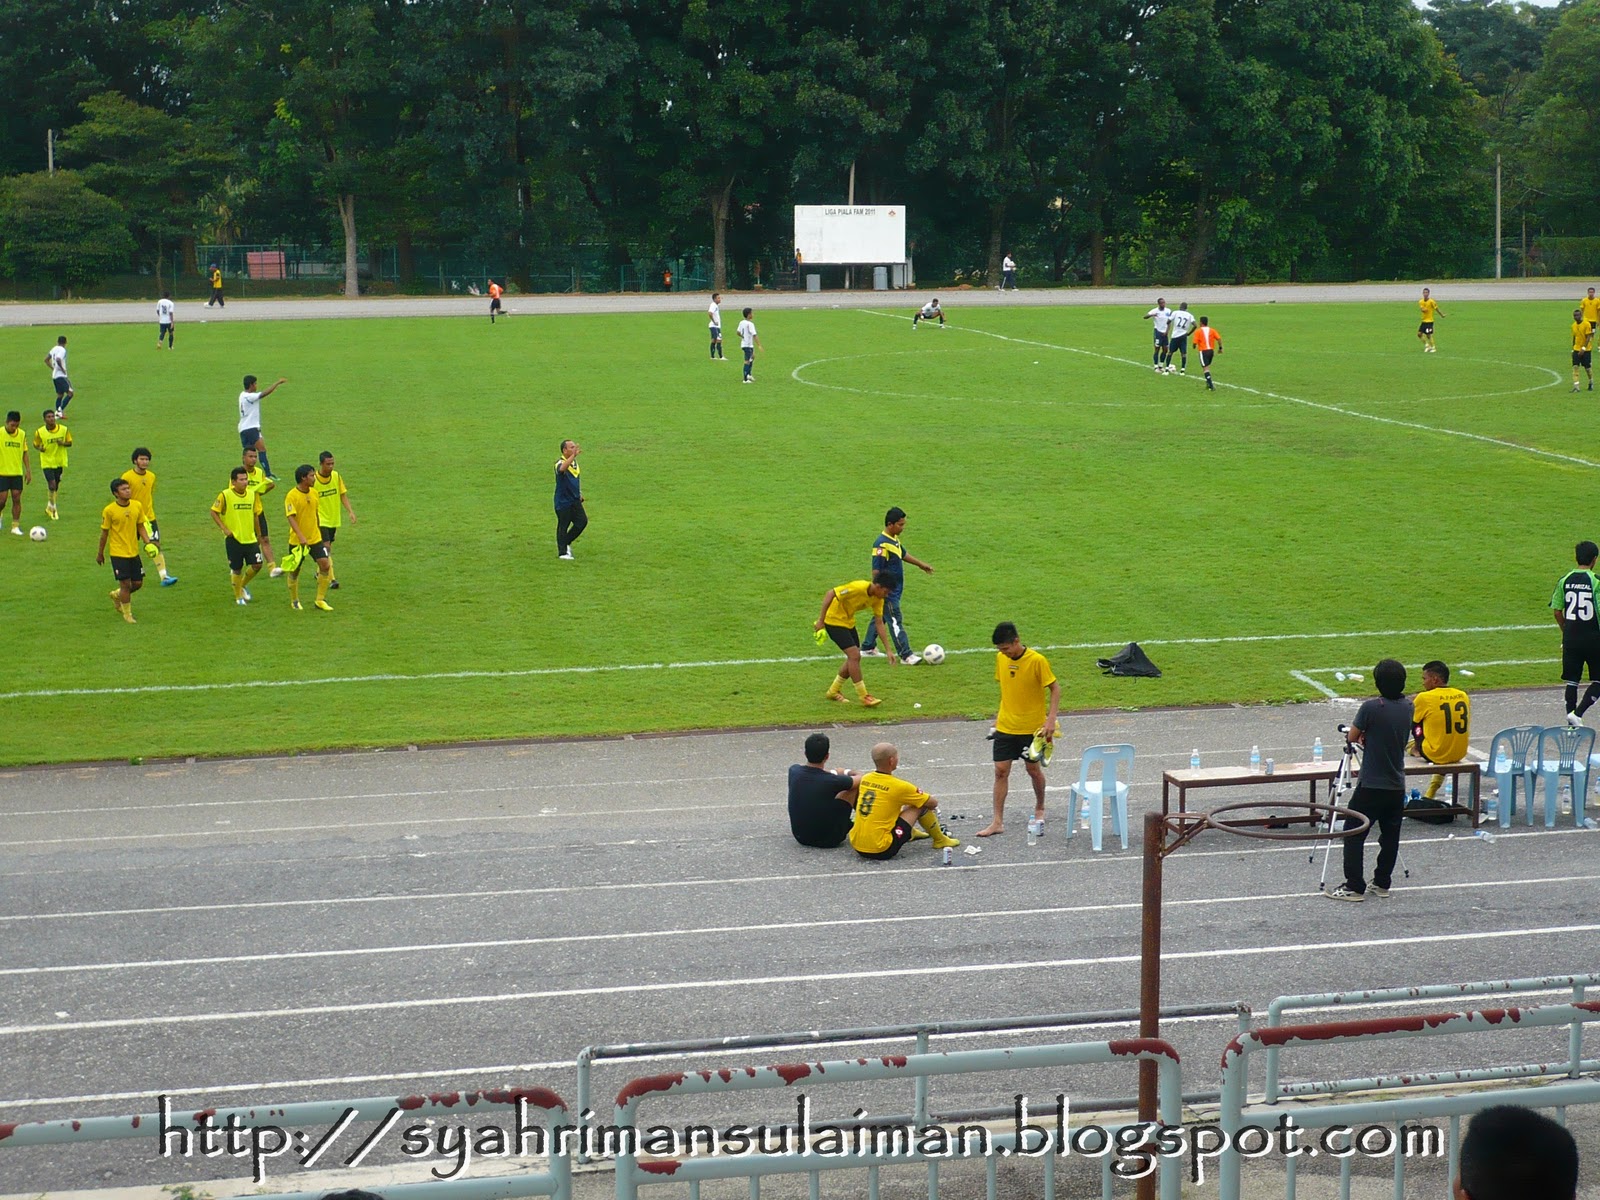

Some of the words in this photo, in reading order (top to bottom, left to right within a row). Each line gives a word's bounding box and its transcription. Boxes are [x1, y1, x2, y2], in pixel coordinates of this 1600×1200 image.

[1176, 316, 1188, 329] 22
[1565, 591, 1594, 621] 25
[1440, 701, 1468, 734] 13
[859, 790, 876, 817] 8
